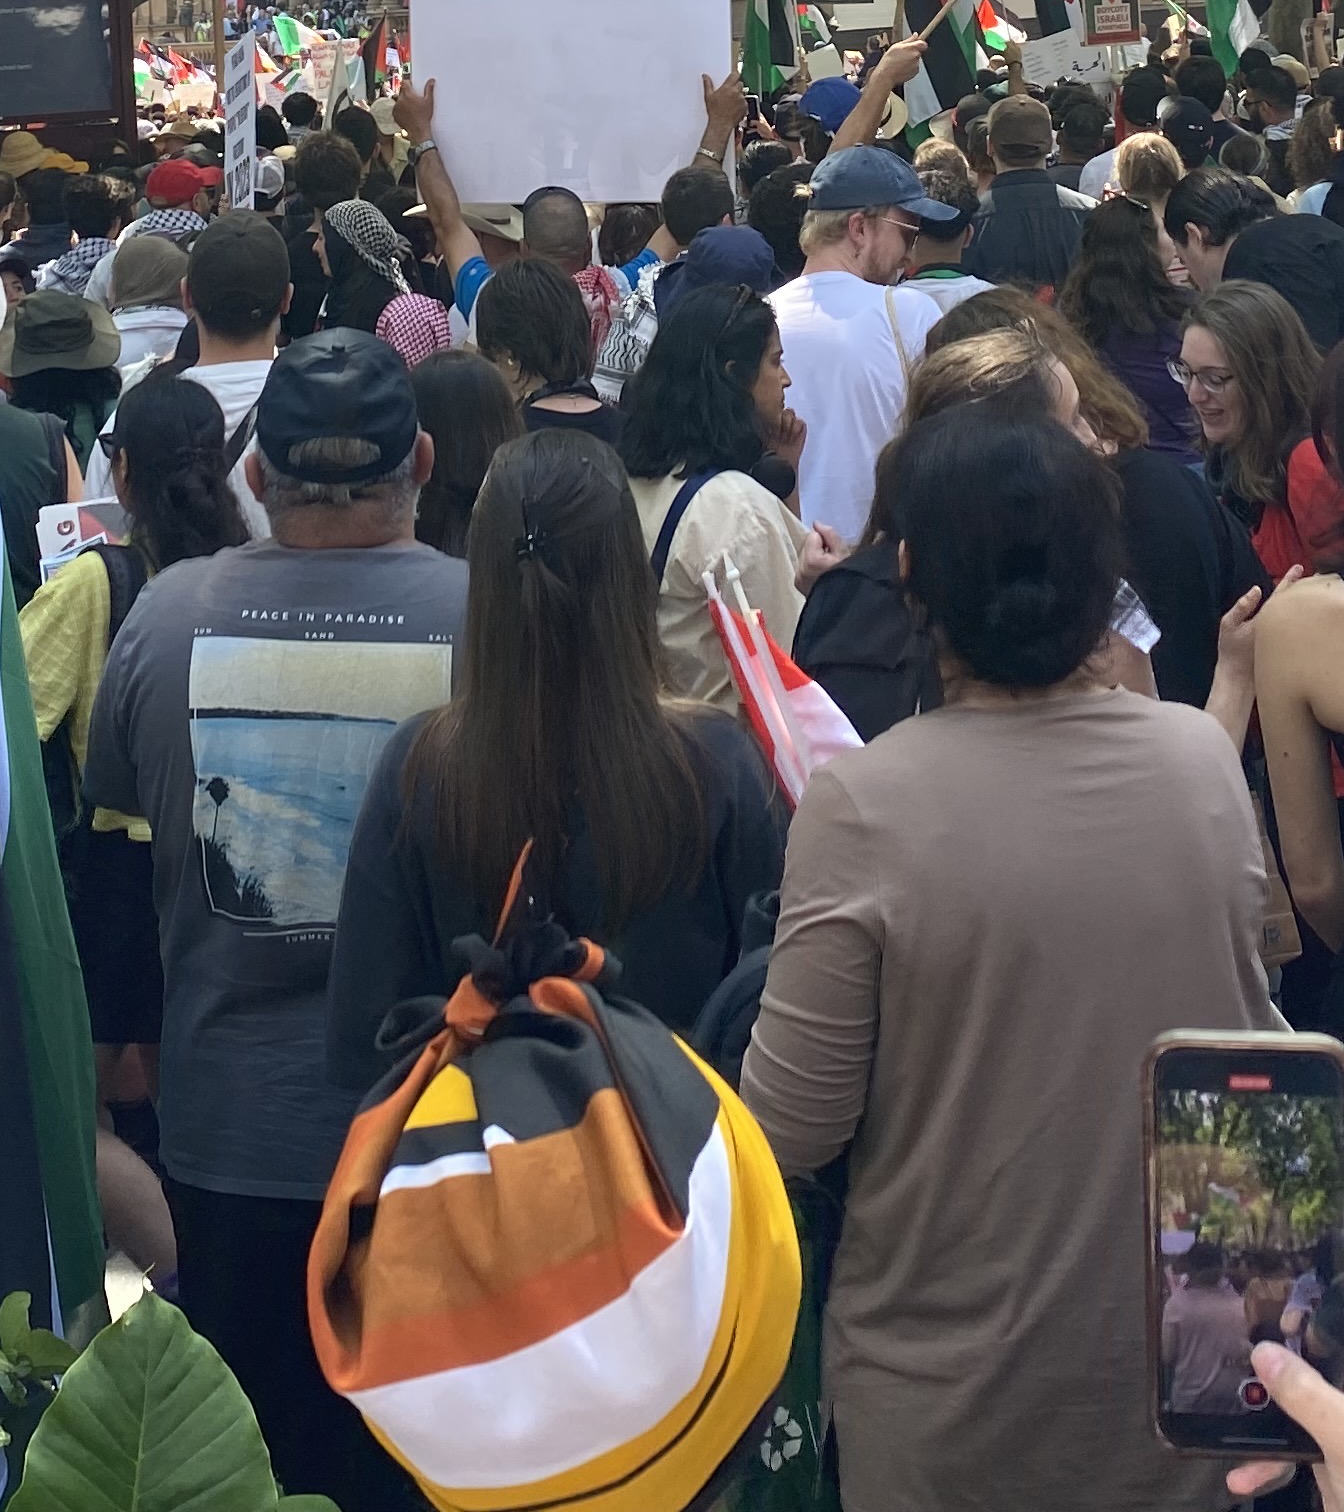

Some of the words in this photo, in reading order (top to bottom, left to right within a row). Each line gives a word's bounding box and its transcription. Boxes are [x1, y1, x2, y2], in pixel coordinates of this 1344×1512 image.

[1096, 5, 1129, 15] BOYCOTT
[1096, 14, 1129, 24] ISRAELI
[241, 609, 290, 622] PEACE
[298, 611, 316, 623] IN
[324, 613, 405, 625] PARADISE
[304, 631, 336, 640] SAND
